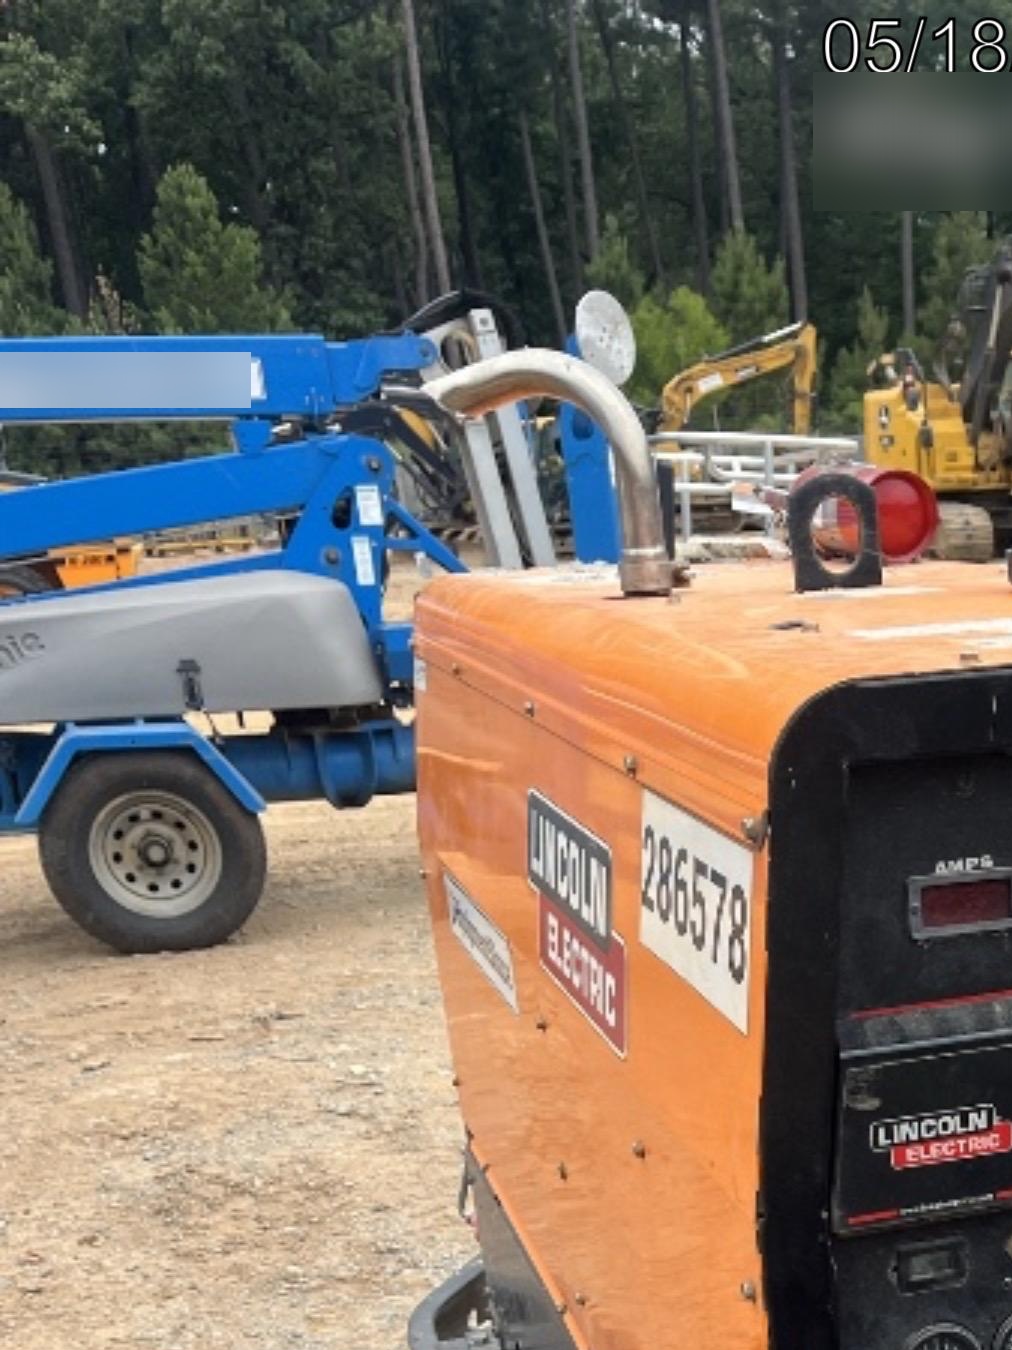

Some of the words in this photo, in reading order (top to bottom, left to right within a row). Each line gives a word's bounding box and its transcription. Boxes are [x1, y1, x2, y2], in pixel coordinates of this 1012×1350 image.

[530, 808, 608, 938] LINCOLN
[935, 854, 995, 875] AMPS
[641, 824, 748, 986] 286578
[546, 912, 617, 1028] ELECTRIC
[876, 1109, 988, 1147] LINCOLN
[905, 1132, 1000, 1163] ELECTRIC
